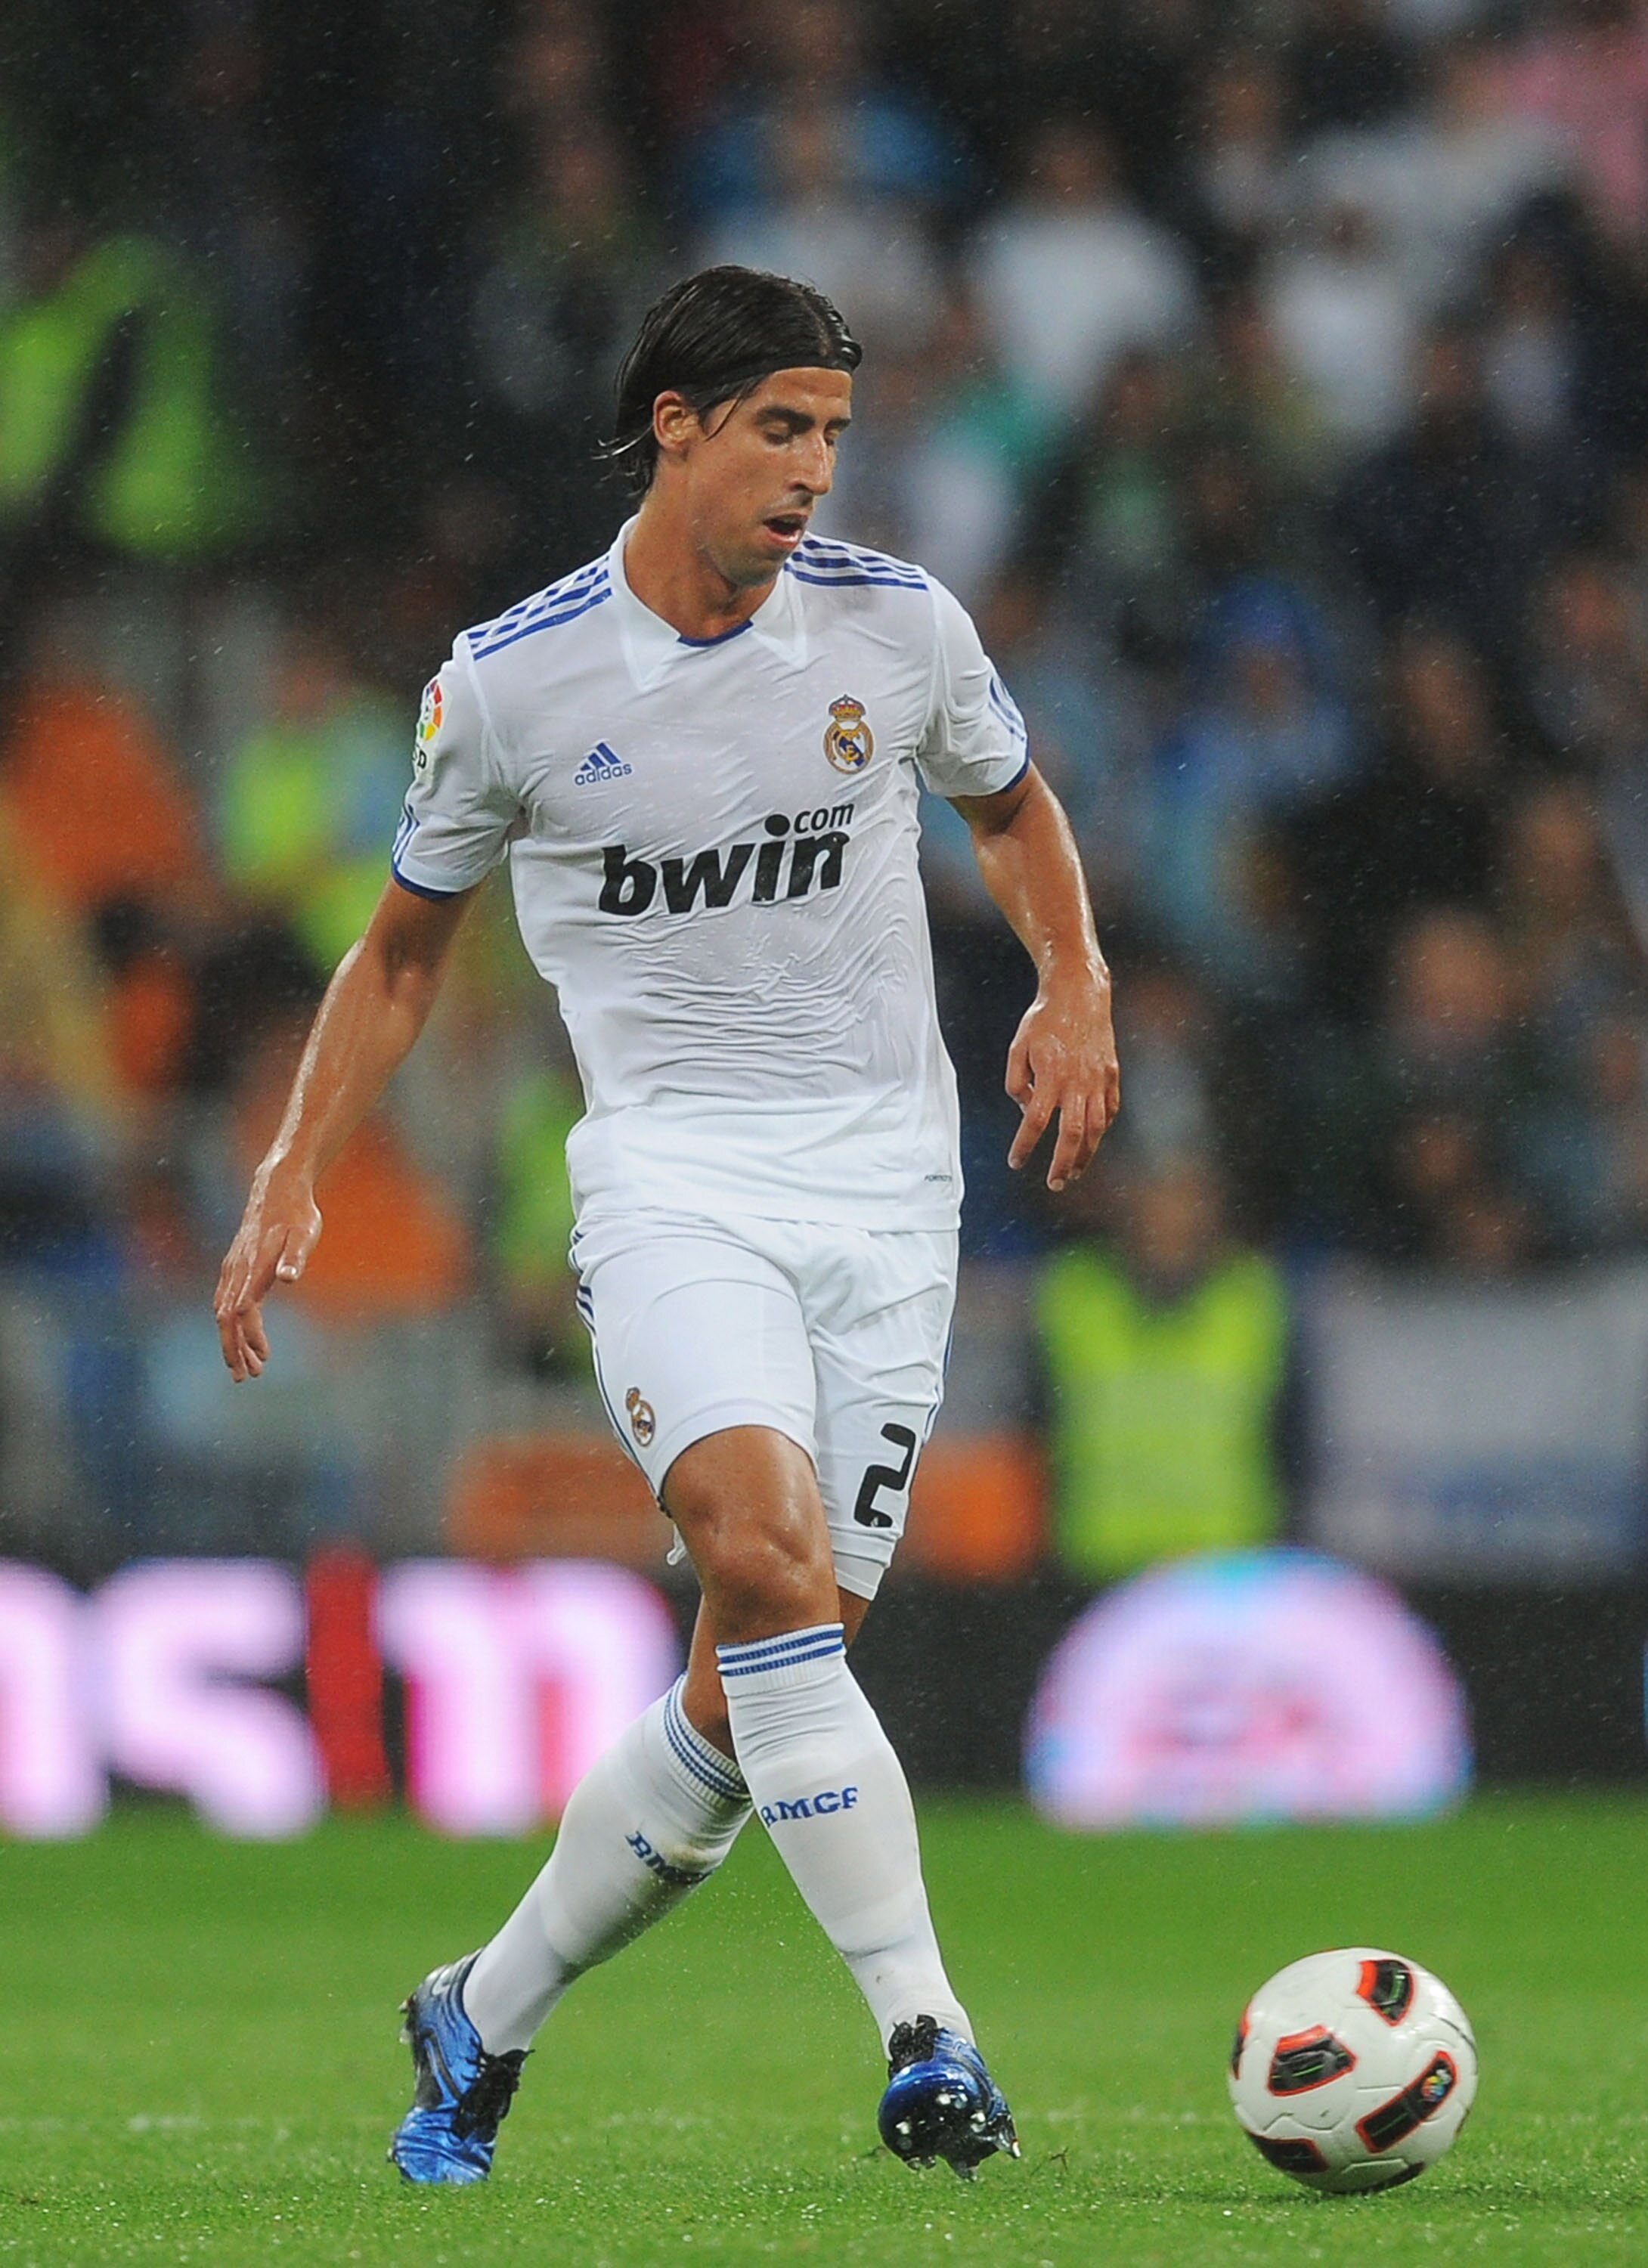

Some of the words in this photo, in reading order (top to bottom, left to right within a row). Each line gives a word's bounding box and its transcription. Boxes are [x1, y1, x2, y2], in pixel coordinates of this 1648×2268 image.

[575, 761, 633, 786] adidas
[598, 813, 850, 916] bwin
[853, 1422, 917, 1529] 2
